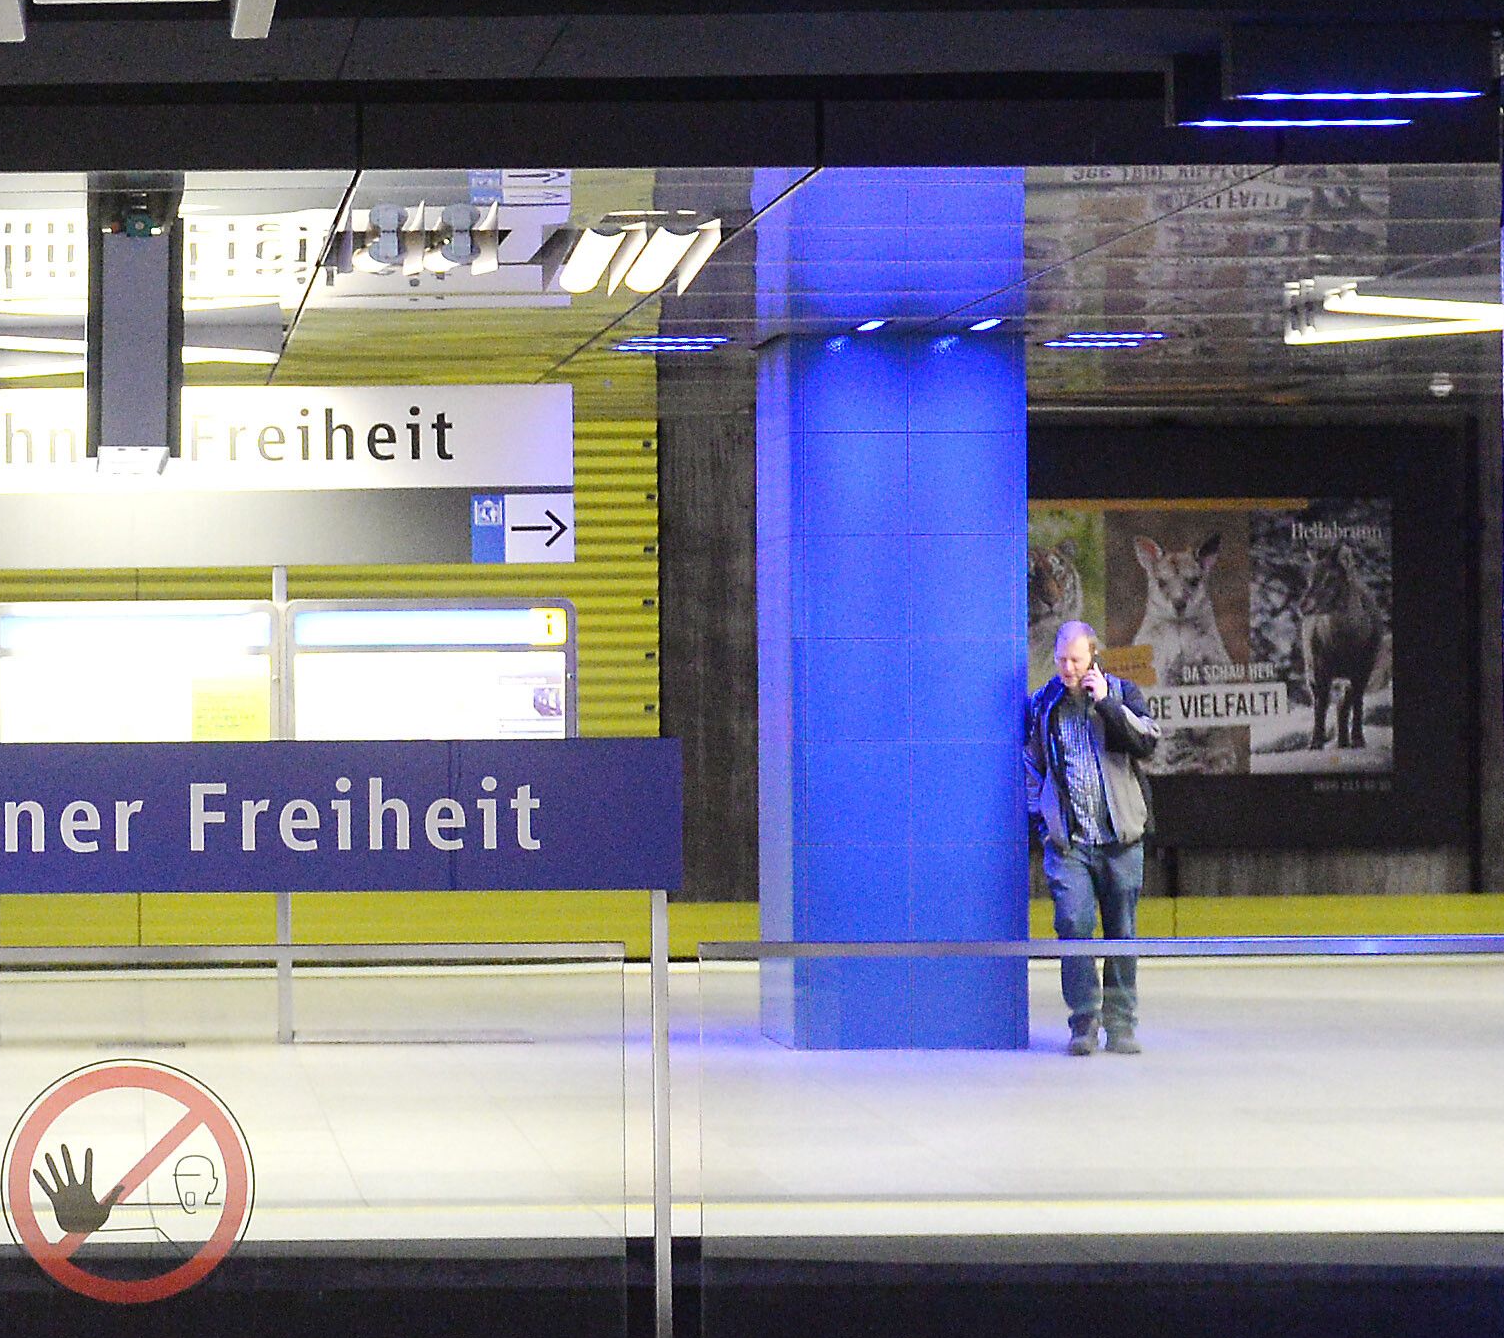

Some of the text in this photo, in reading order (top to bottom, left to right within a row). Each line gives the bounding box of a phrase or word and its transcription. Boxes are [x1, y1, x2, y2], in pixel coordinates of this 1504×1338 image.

[190, 405, 455, 462] Freiheit
[1147, 695, 1172, 720] GE
[189, 775, 543, 852] Freiheit
